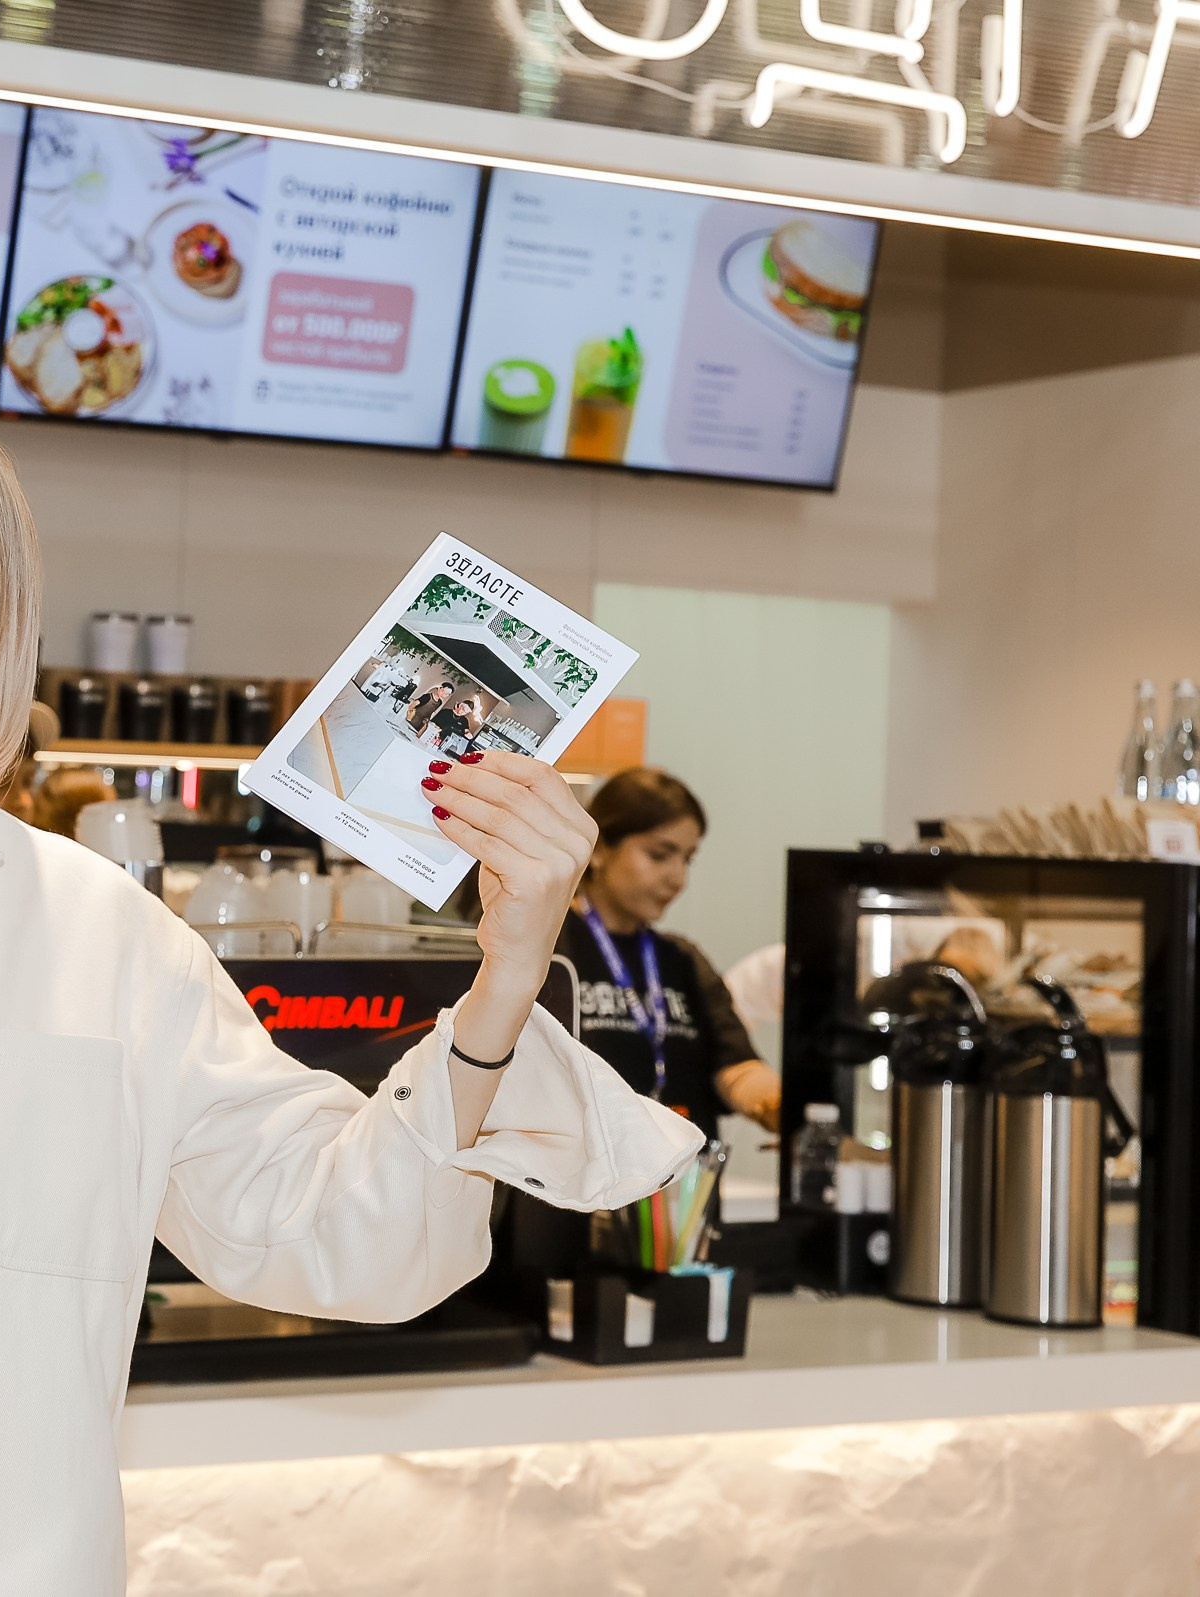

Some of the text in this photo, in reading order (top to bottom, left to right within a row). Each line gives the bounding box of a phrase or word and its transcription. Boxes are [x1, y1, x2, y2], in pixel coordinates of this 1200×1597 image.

[445, 552, 524, 607] ЗДРАСТЕ
[562, 623, 590, 643] франшиза
[562, 632, 590, 652] авторской
[589, 650, 608, 664] кухней
[270, 774, 289, 787] работы
[294, 788, 310, 801] рынке
[289, 776, 313, 794] успешной
[339, 811, 370, 832] окупаемость
[397, 857, 435, 883] чистой прибыли
[245, 984, 405, 1031] CIMBALI
